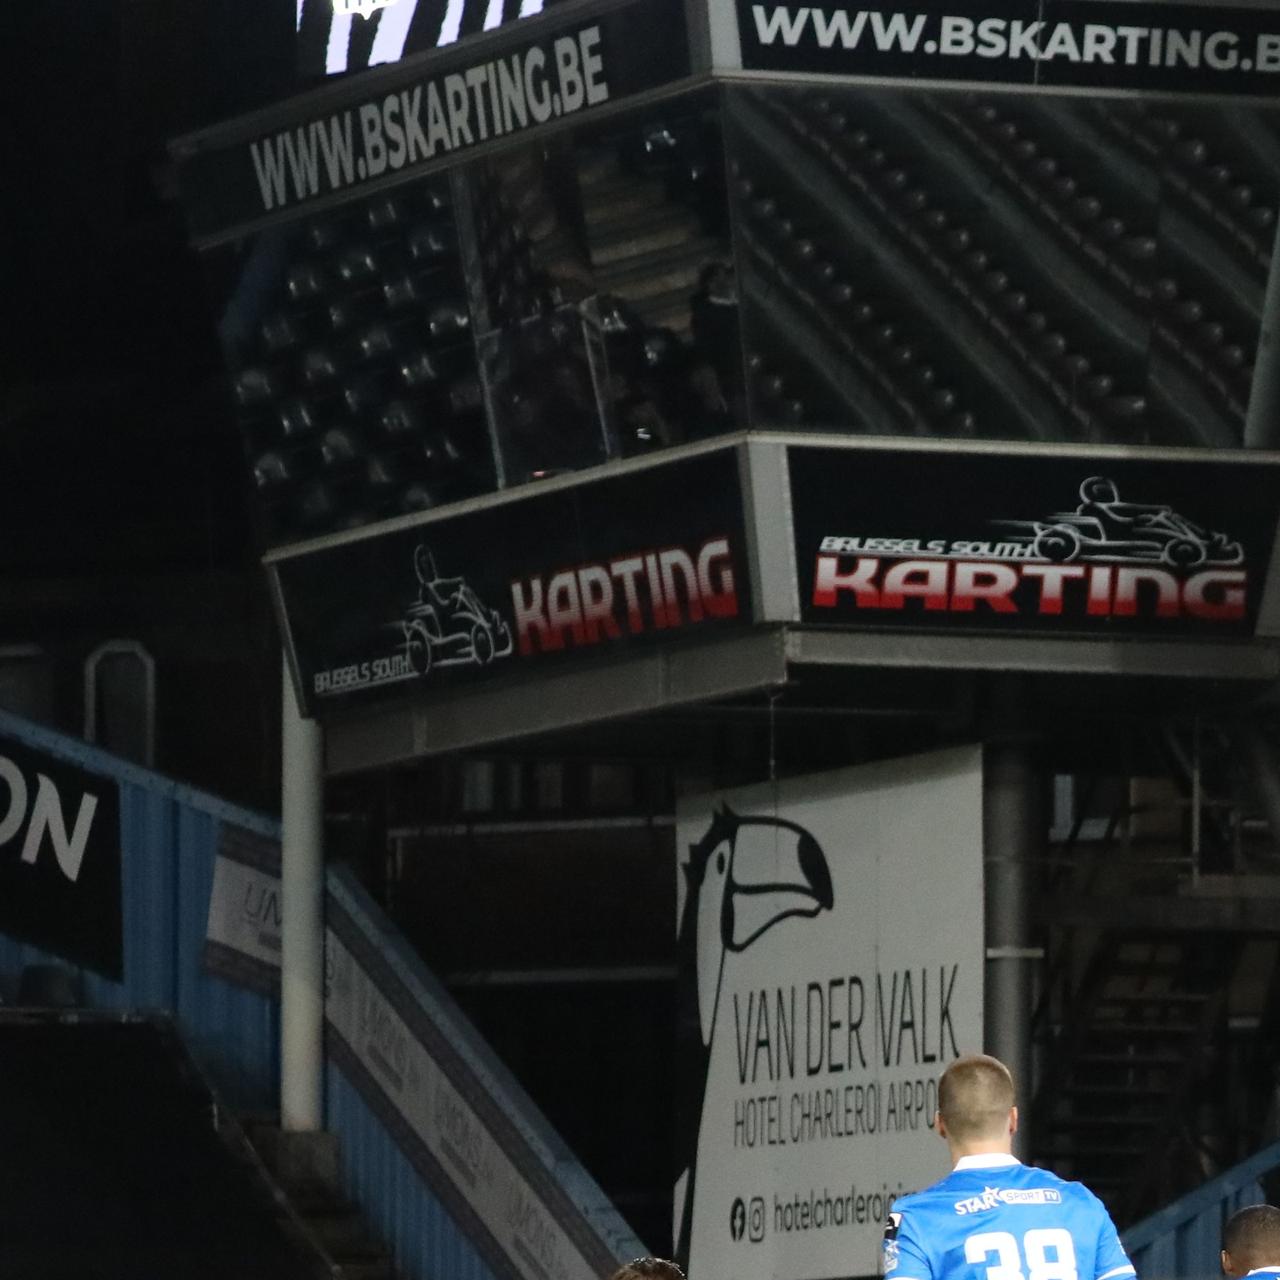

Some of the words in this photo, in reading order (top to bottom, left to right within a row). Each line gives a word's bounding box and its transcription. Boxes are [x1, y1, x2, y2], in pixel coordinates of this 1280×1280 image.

[250, 26, 608, 210] WWW.BSKARTING.BE
[820, 536, 947, 556] BRUSSELS
[511, 536, 739, 656] KARTING
[812, 557, 1248, 622] KARTING
[733, 985, 796, 1085] VAN
[806, 976, 867, 1077] DER
[876, 963, 961, 1068] VALK
[733, 1094, 787, 1149] HOTEL
[791, 1082, 881, 1146] CHARLEROI
[886, 1077, 939, 1132] AIRPO
[954, 1191, 1000, 1216] STAR
[1006, 1191, 1041, 1203] SPORT
[1045, 1190, 1059, 1203] TV
